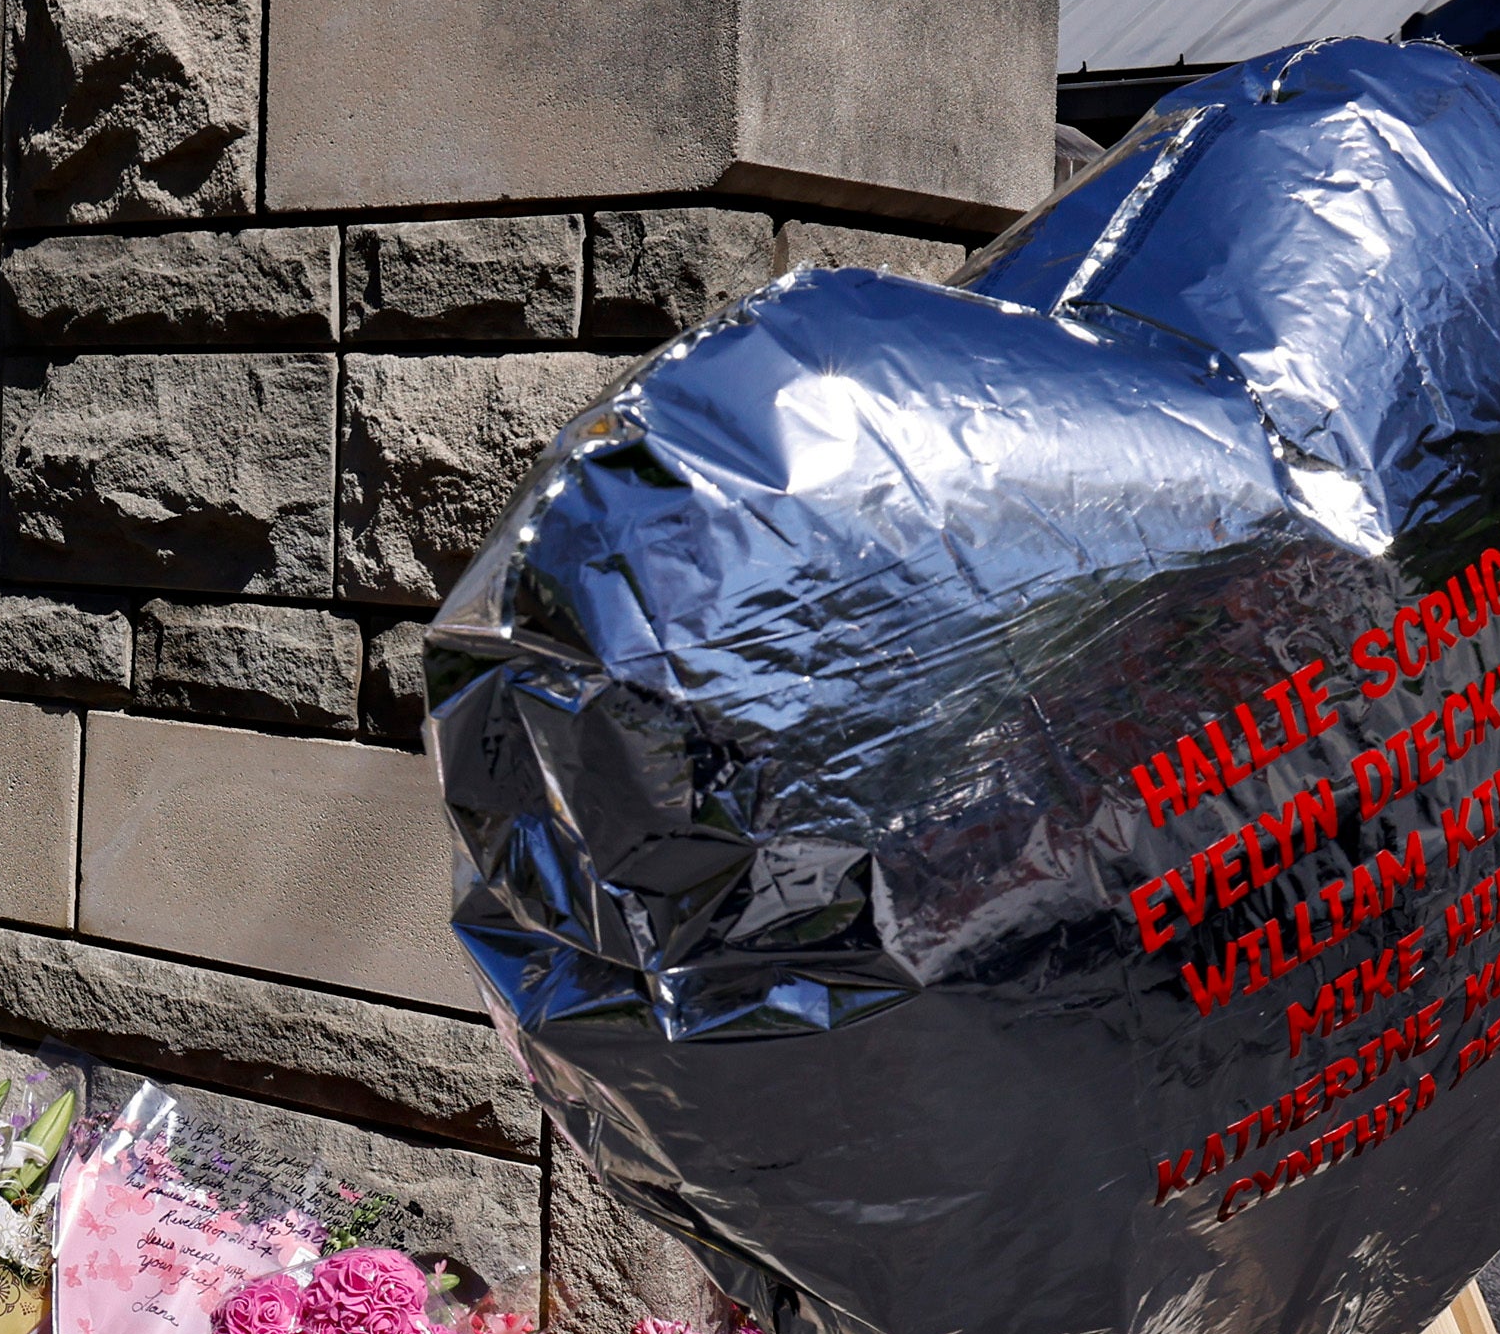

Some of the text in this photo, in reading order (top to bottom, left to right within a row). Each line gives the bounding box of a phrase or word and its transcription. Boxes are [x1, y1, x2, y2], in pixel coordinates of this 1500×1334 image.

[1131, 659, 1340, 829] HALLIE
[1128, 779, 1339, 954] EVELYN
[1181, 830, 1427, 1018] WILLIAM
[1287, 926, 1425, 1058] MIKE
[1154, 998, 1444, 1207] KATHERINE
[1217, 1074, 1436, 1223] CYNTHIA
[159, 1210, 227, 1240] Revelation
